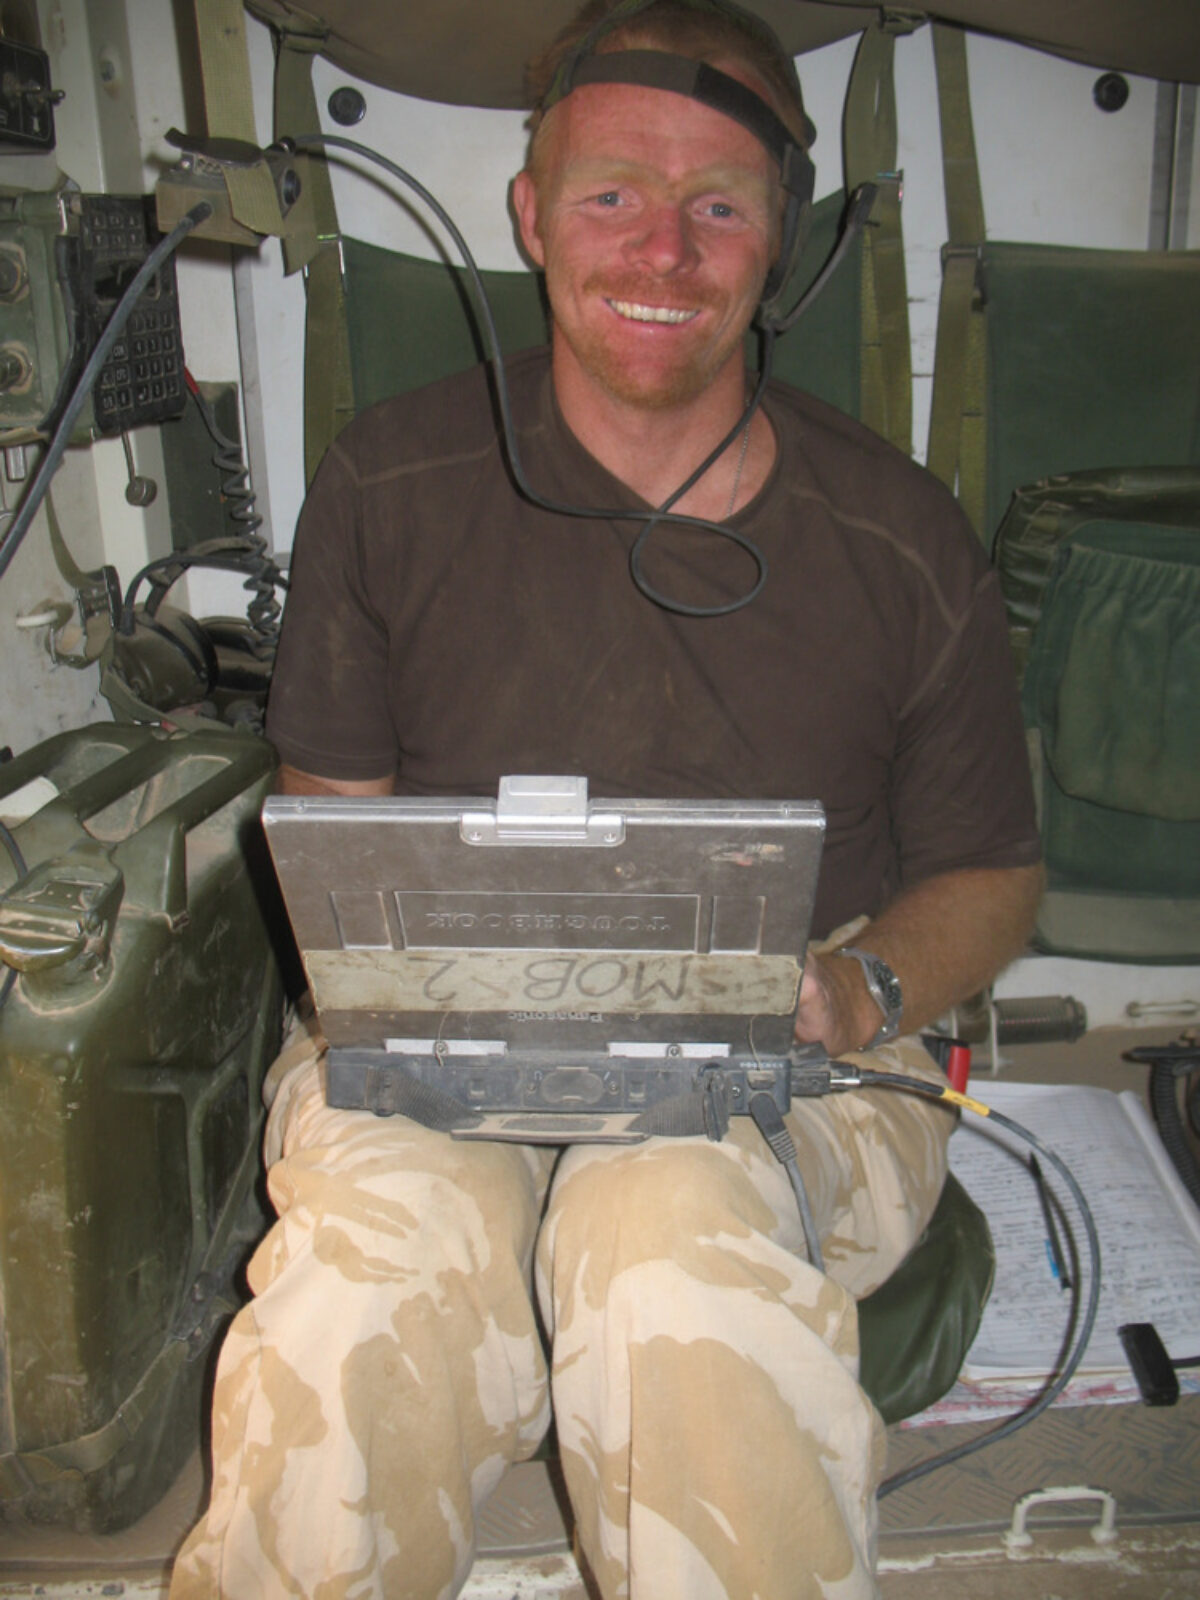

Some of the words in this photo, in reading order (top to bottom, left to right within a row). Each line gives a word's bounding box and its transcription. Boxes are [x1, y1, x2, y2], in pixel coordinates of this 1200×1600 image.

[425, 911, 670, 933] TOUGHBOOK
[409, 957, 458, 1003] 2
[523, 956, 692, 1002] MOB
[507, 1011, 603, 1024] Panasonic
